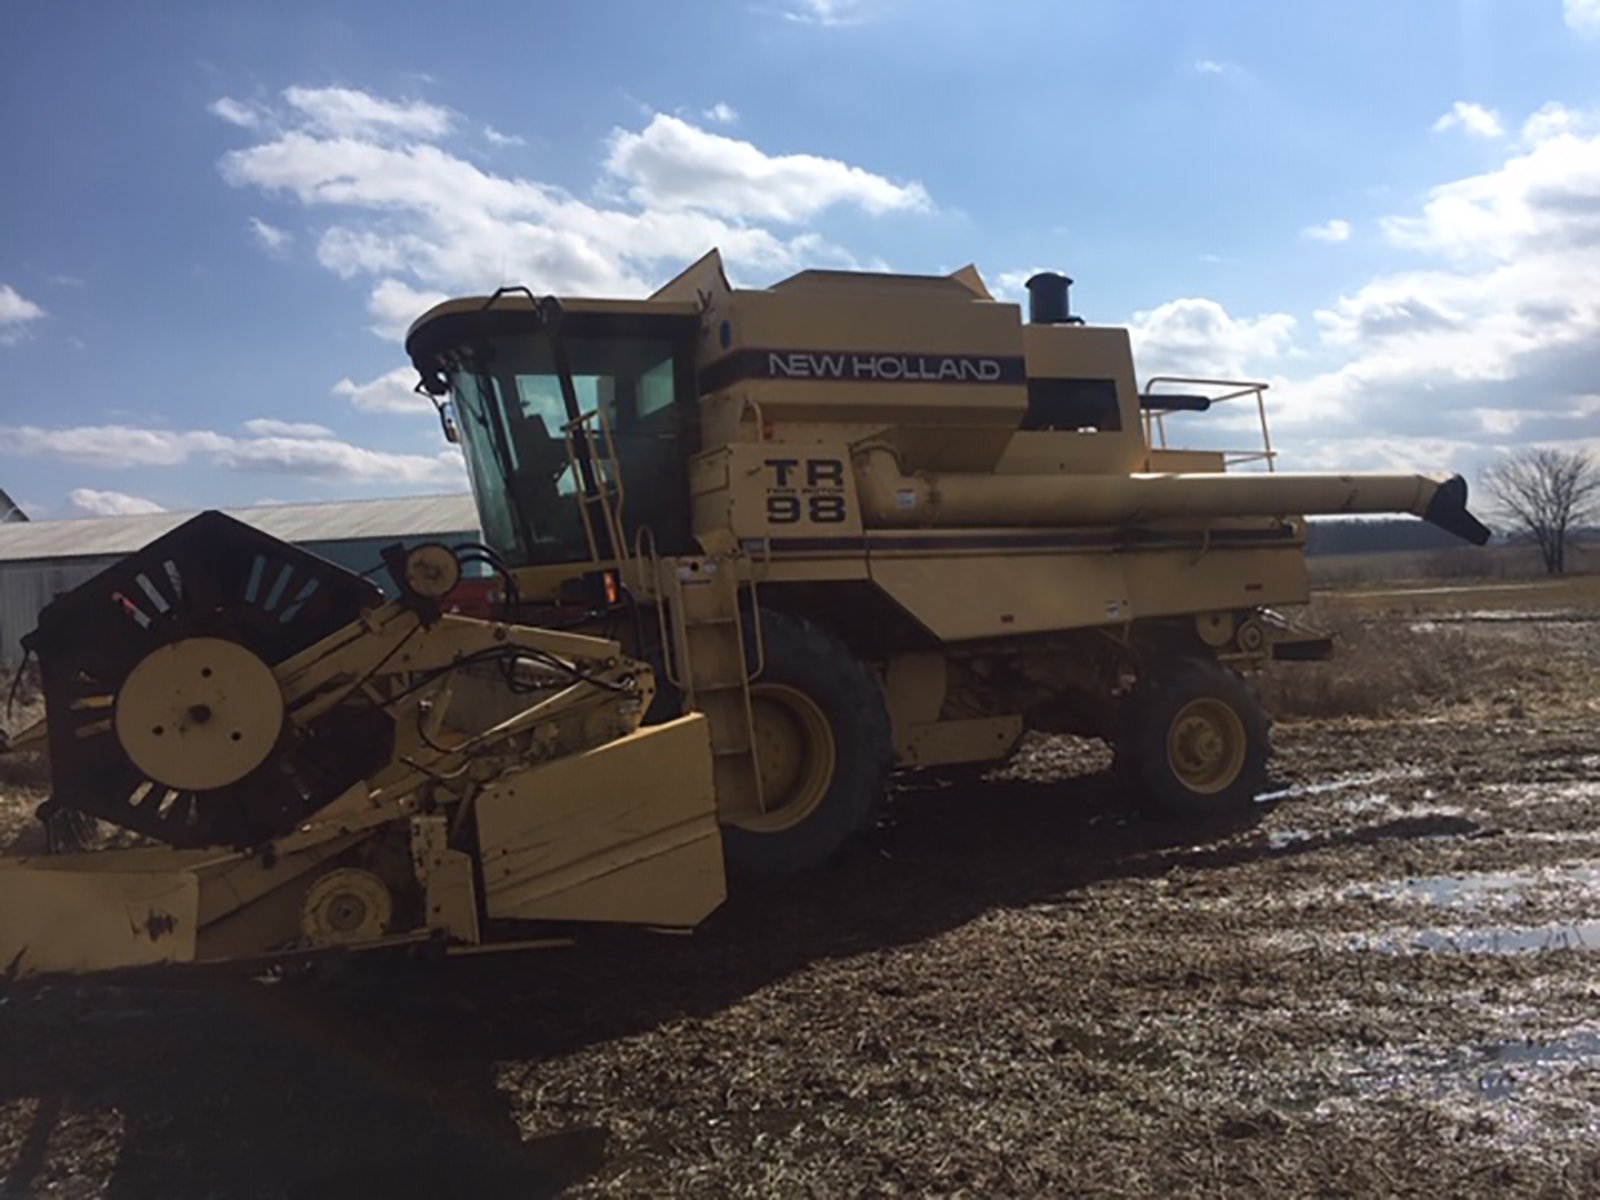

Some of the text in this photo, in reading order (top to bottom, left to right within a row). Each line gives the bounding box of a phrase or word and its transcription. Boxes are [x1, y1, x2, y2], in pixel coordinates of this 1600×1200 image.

[769, 353, 1001, 380] NEW HOLLAND
[764, 459, 843, 487] TR
[767, 496, 846, 523] 98
